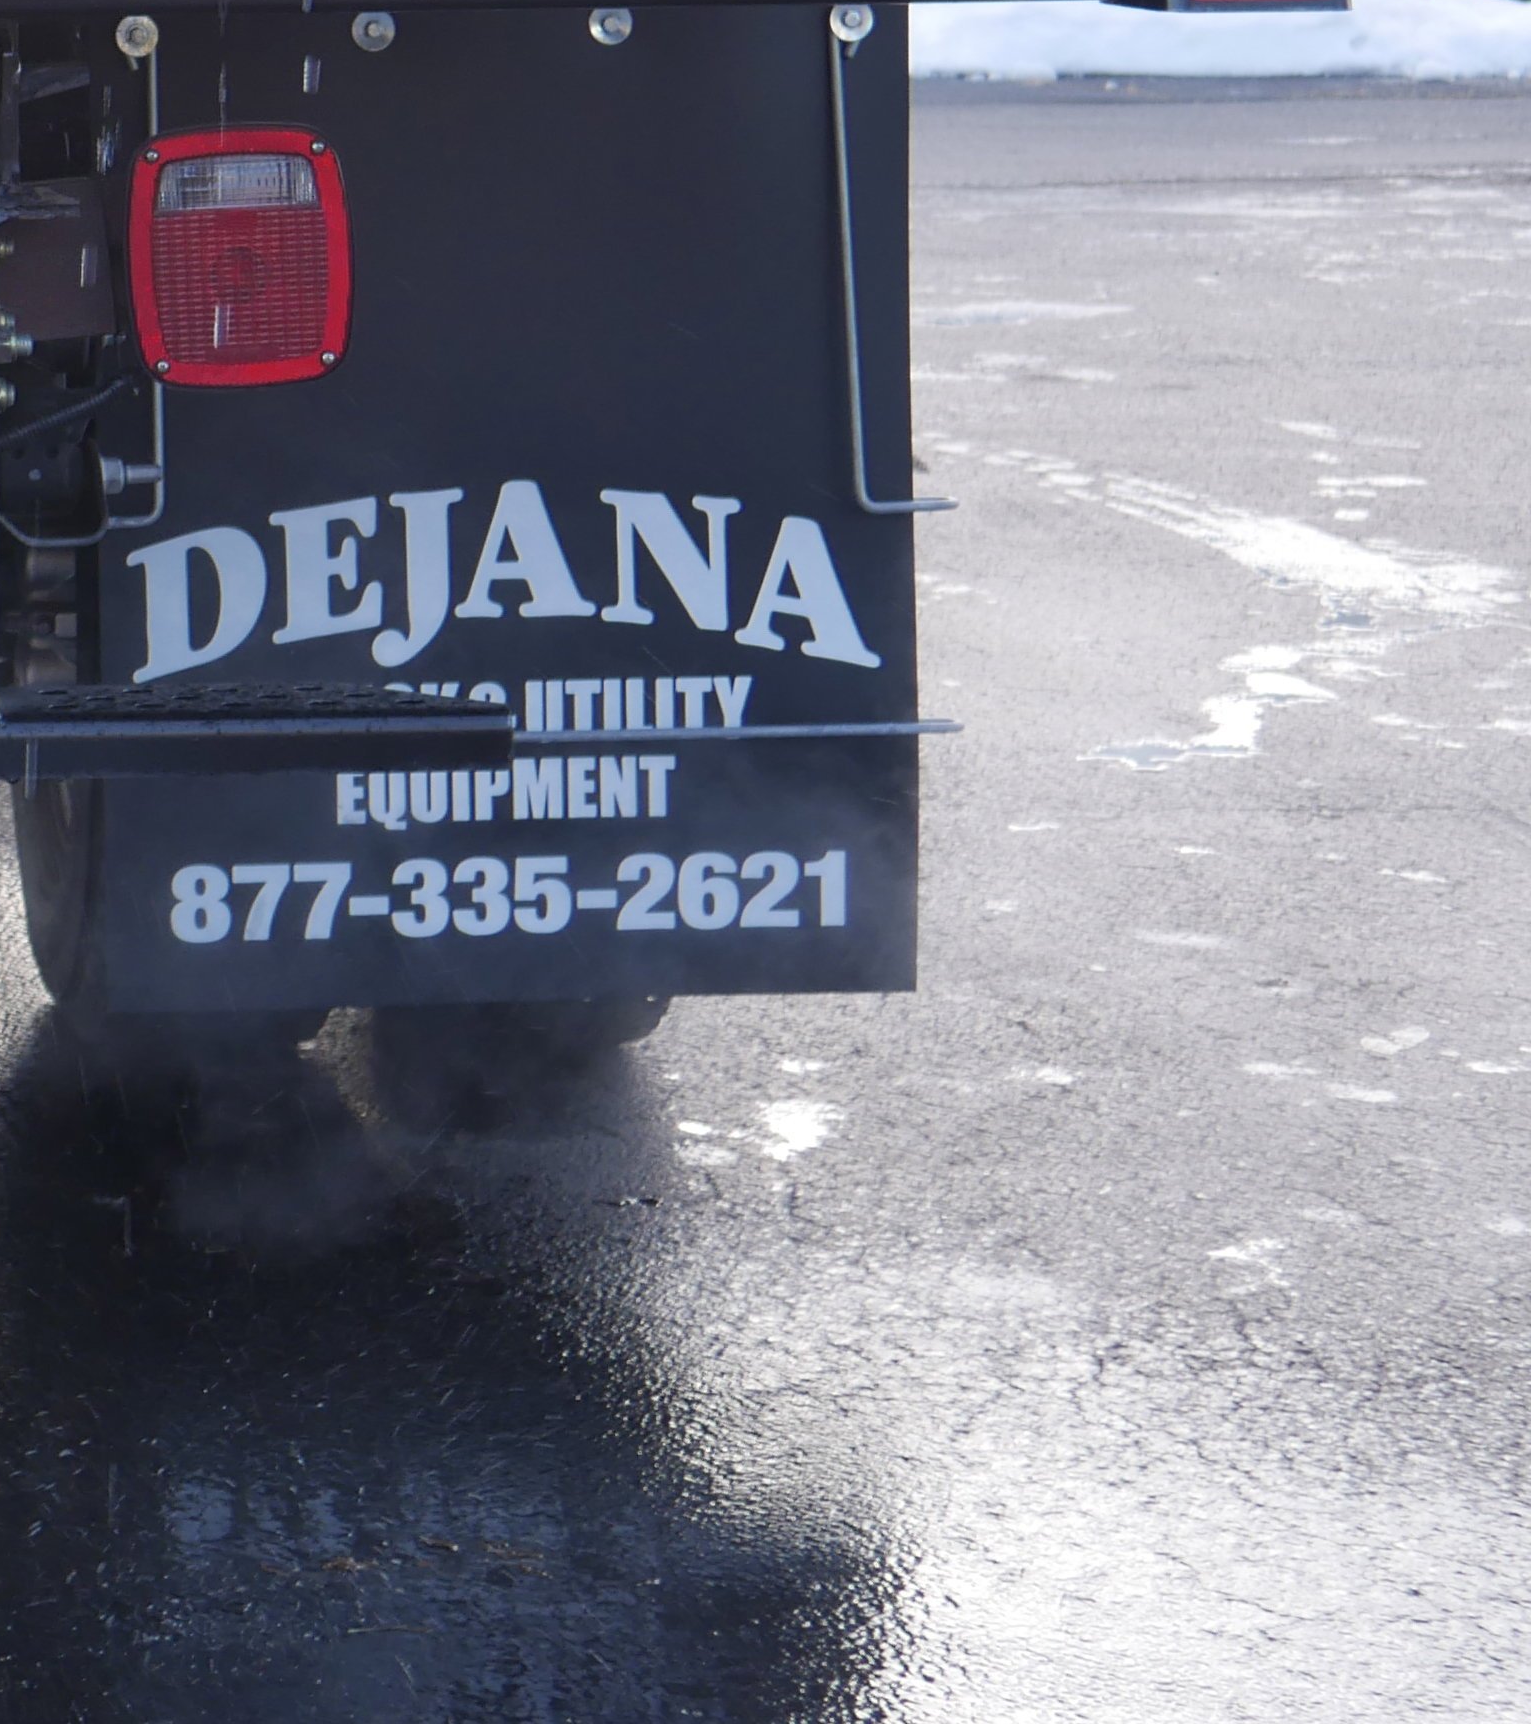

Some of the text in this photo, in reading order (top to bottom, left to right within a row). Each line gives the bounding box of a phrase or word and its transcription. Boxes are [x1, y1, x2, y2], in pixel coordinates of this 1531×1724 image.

[125, 478, 882, 685] DEJANA
[525, 675, 754, 732] UTILITY
[336, 754, 677, 832] EQUIPMENT
[170, 849, 849, 945] 877-335-2621
